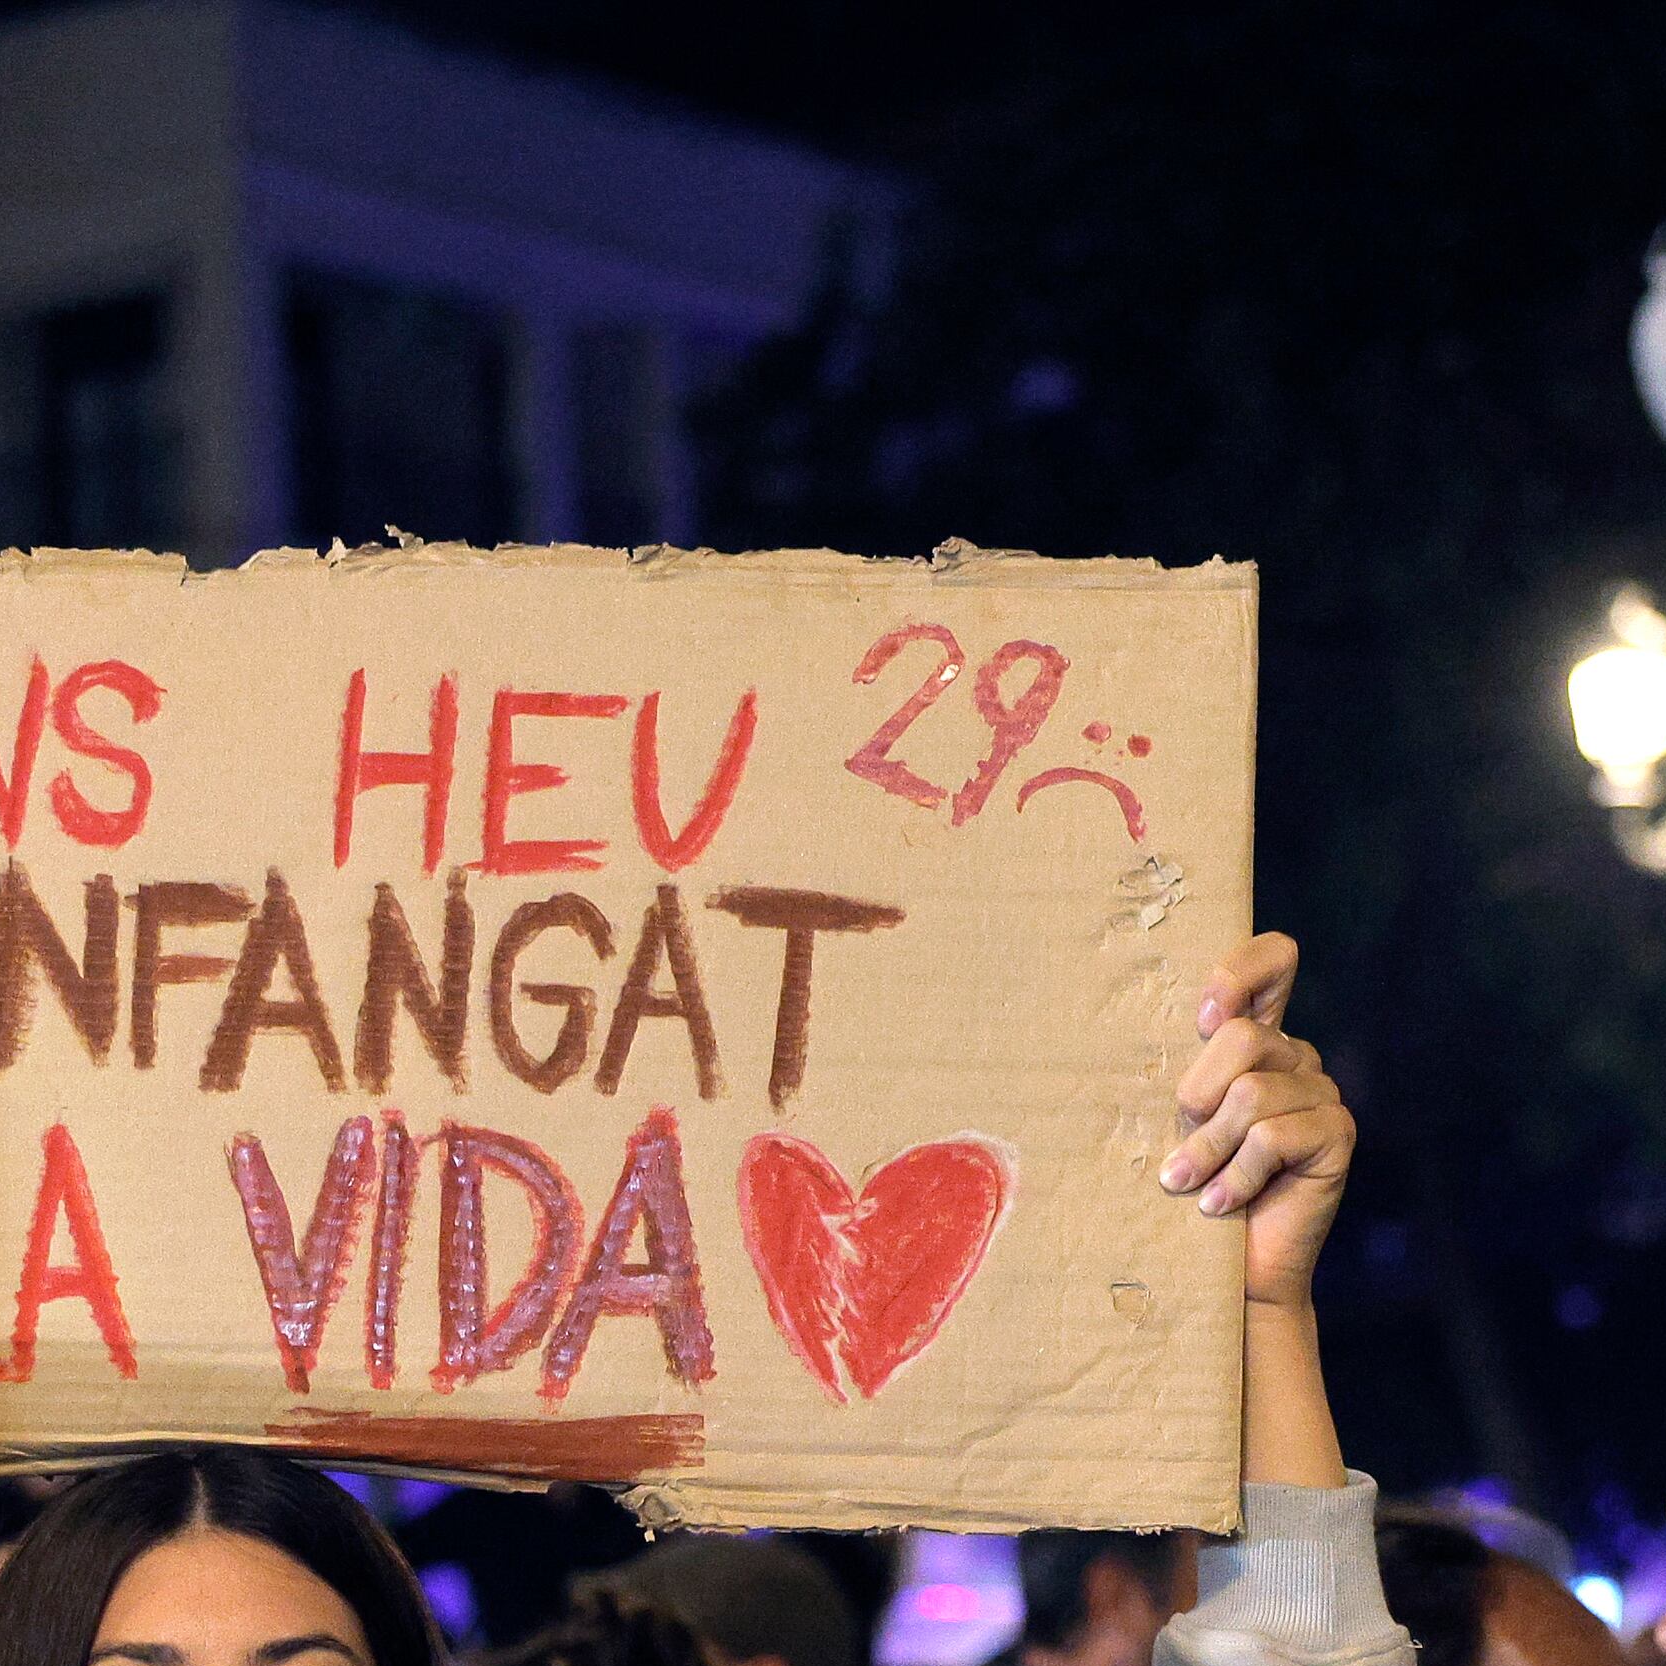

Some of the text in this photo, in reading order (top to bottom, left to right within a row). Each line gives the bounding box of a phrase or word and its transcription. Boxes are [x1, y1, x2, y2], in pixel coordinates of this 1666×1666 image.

[333, 666, 758, 875] HEU
[844, 613, 1071, 828] 29
[223, 1105, 717, 1410] VIDA
